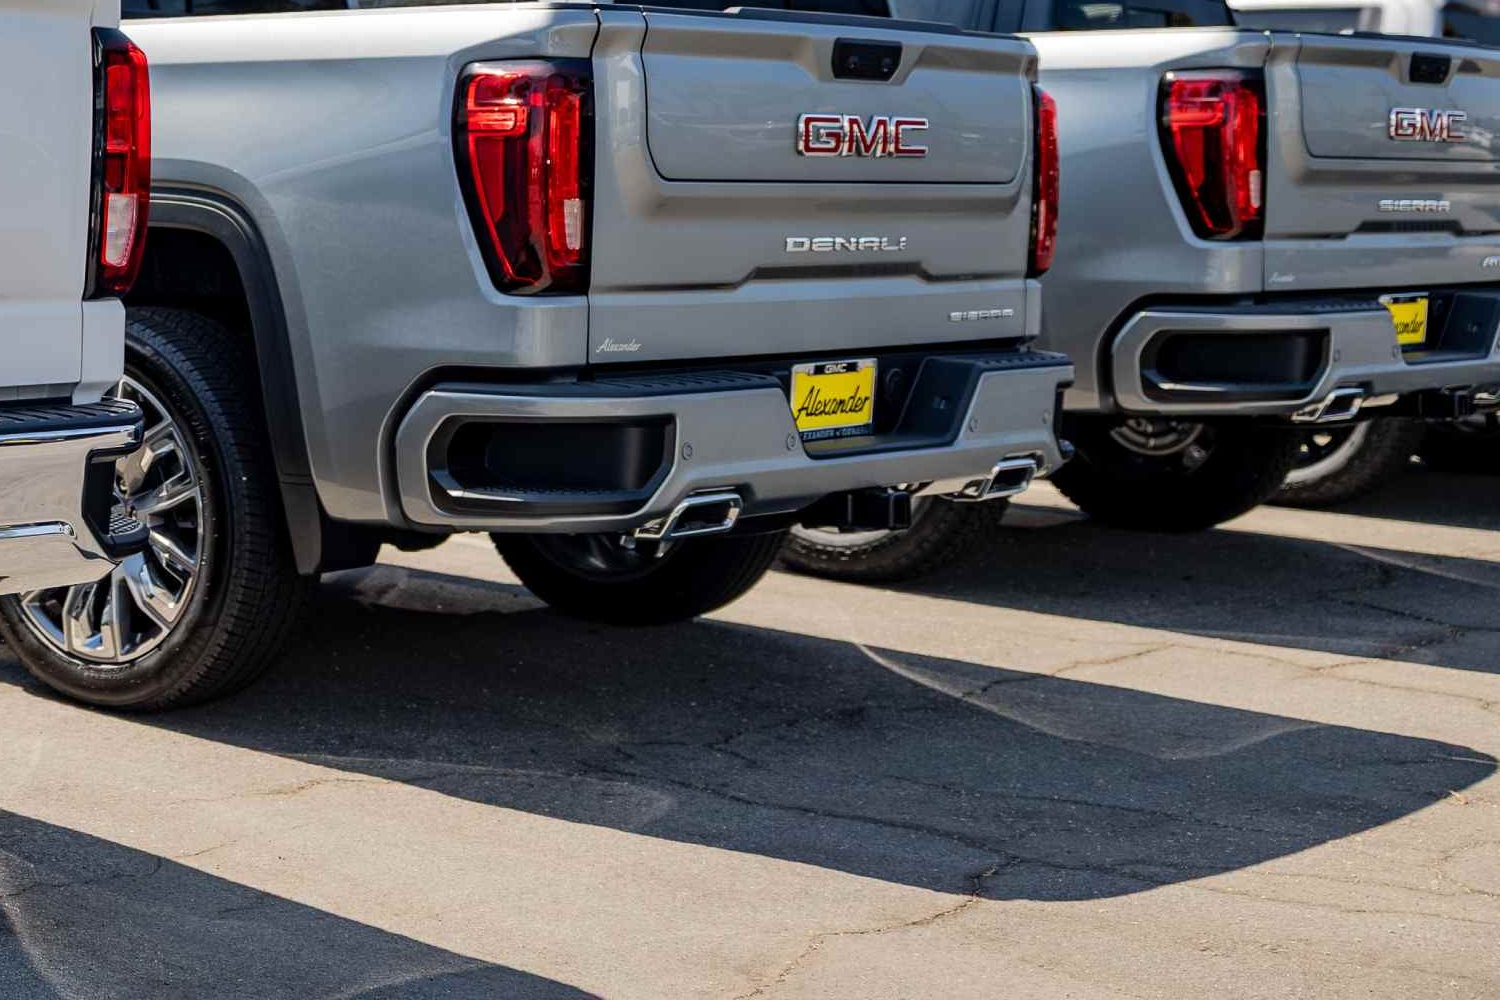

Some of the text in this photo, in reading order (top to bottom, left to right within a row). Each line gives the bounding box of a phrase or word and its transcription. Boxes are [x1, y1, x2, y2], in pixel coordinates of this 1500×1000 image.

[1387, 107, 1468, 142] GMC
[797, 113, 928, 157] GMC
[1379, 199, 1450, 213] SIERRA
[786, 236, 907, 252] DENALI
[949, 308, 1013, 321] SIERRA
[595, 337, 642, 352] Alexander
[824, 363, 848, 374] GMC
[796, 385, 870, 420] Alexander
